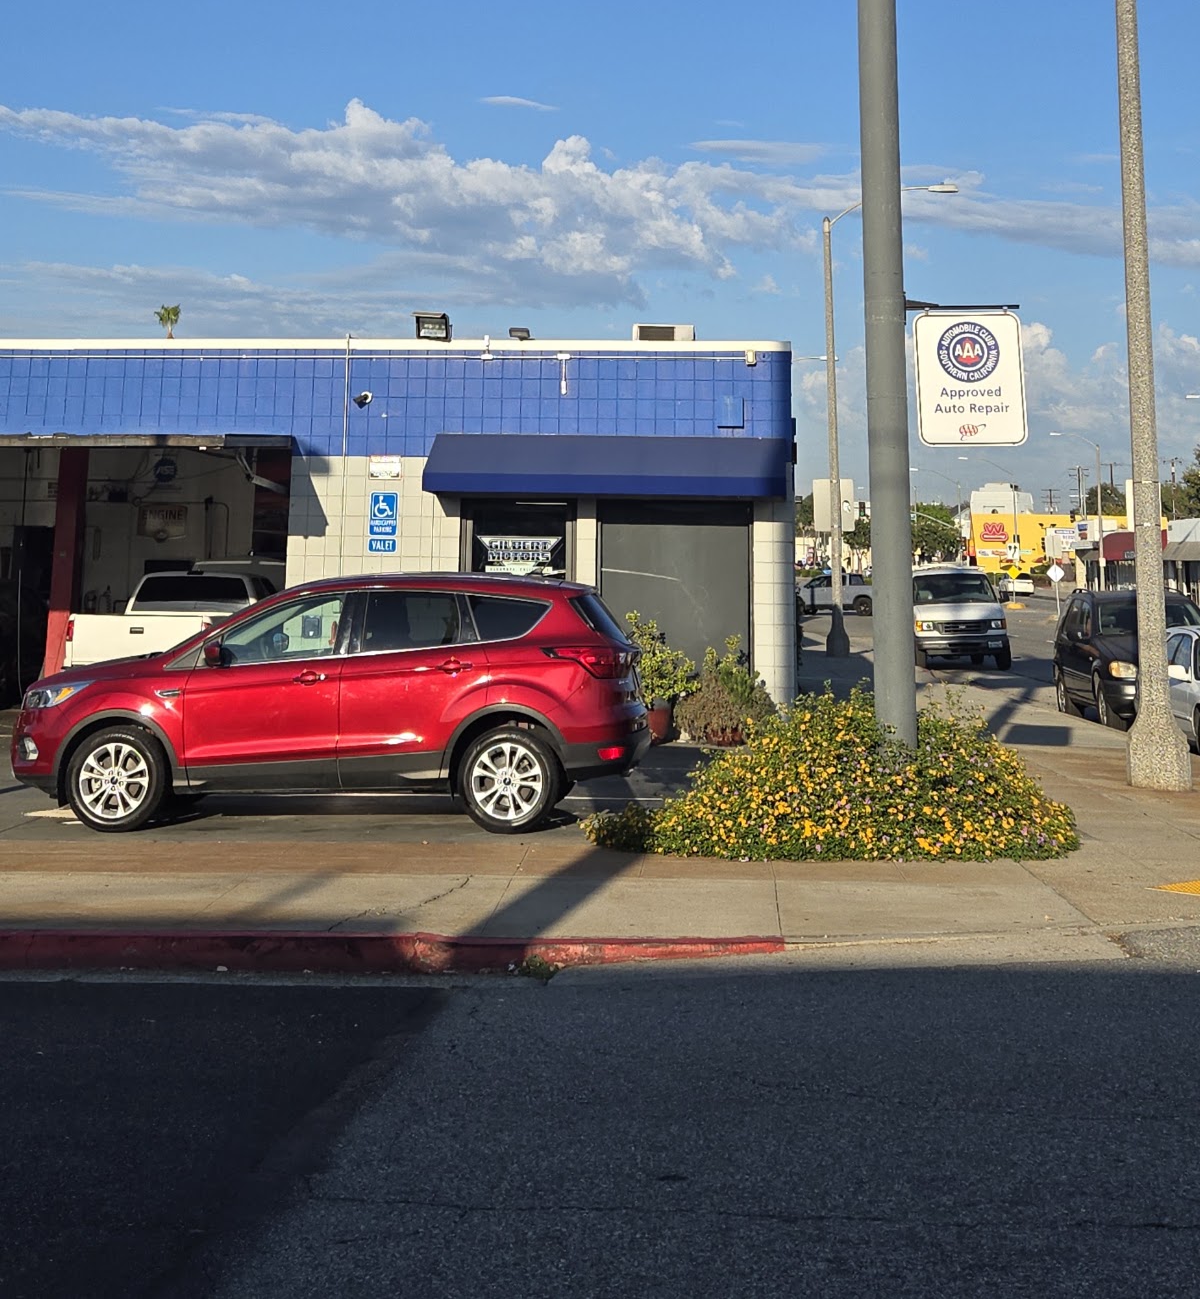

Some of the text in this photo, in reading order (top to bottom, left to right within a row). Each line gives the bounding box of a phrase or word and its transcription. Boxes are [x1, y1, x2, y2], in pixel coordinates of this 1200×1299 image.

[941, 323, 996, 347] AUTOMOBILE CLUB
[954, 342, 983, 359] AAA
[939, 349, 998, 381] SOUTHERN CALIFORNIA
[940, 386, 1002, 400] Approved
[934, 402, 1010, 416] Auto Repair
[142, 509, 183, 520] ENGINE
[371, 540, 393, 551] VALET
[488, 539, 551, 550] GILBERT
[488, 551, 551, 561] MOTORS
